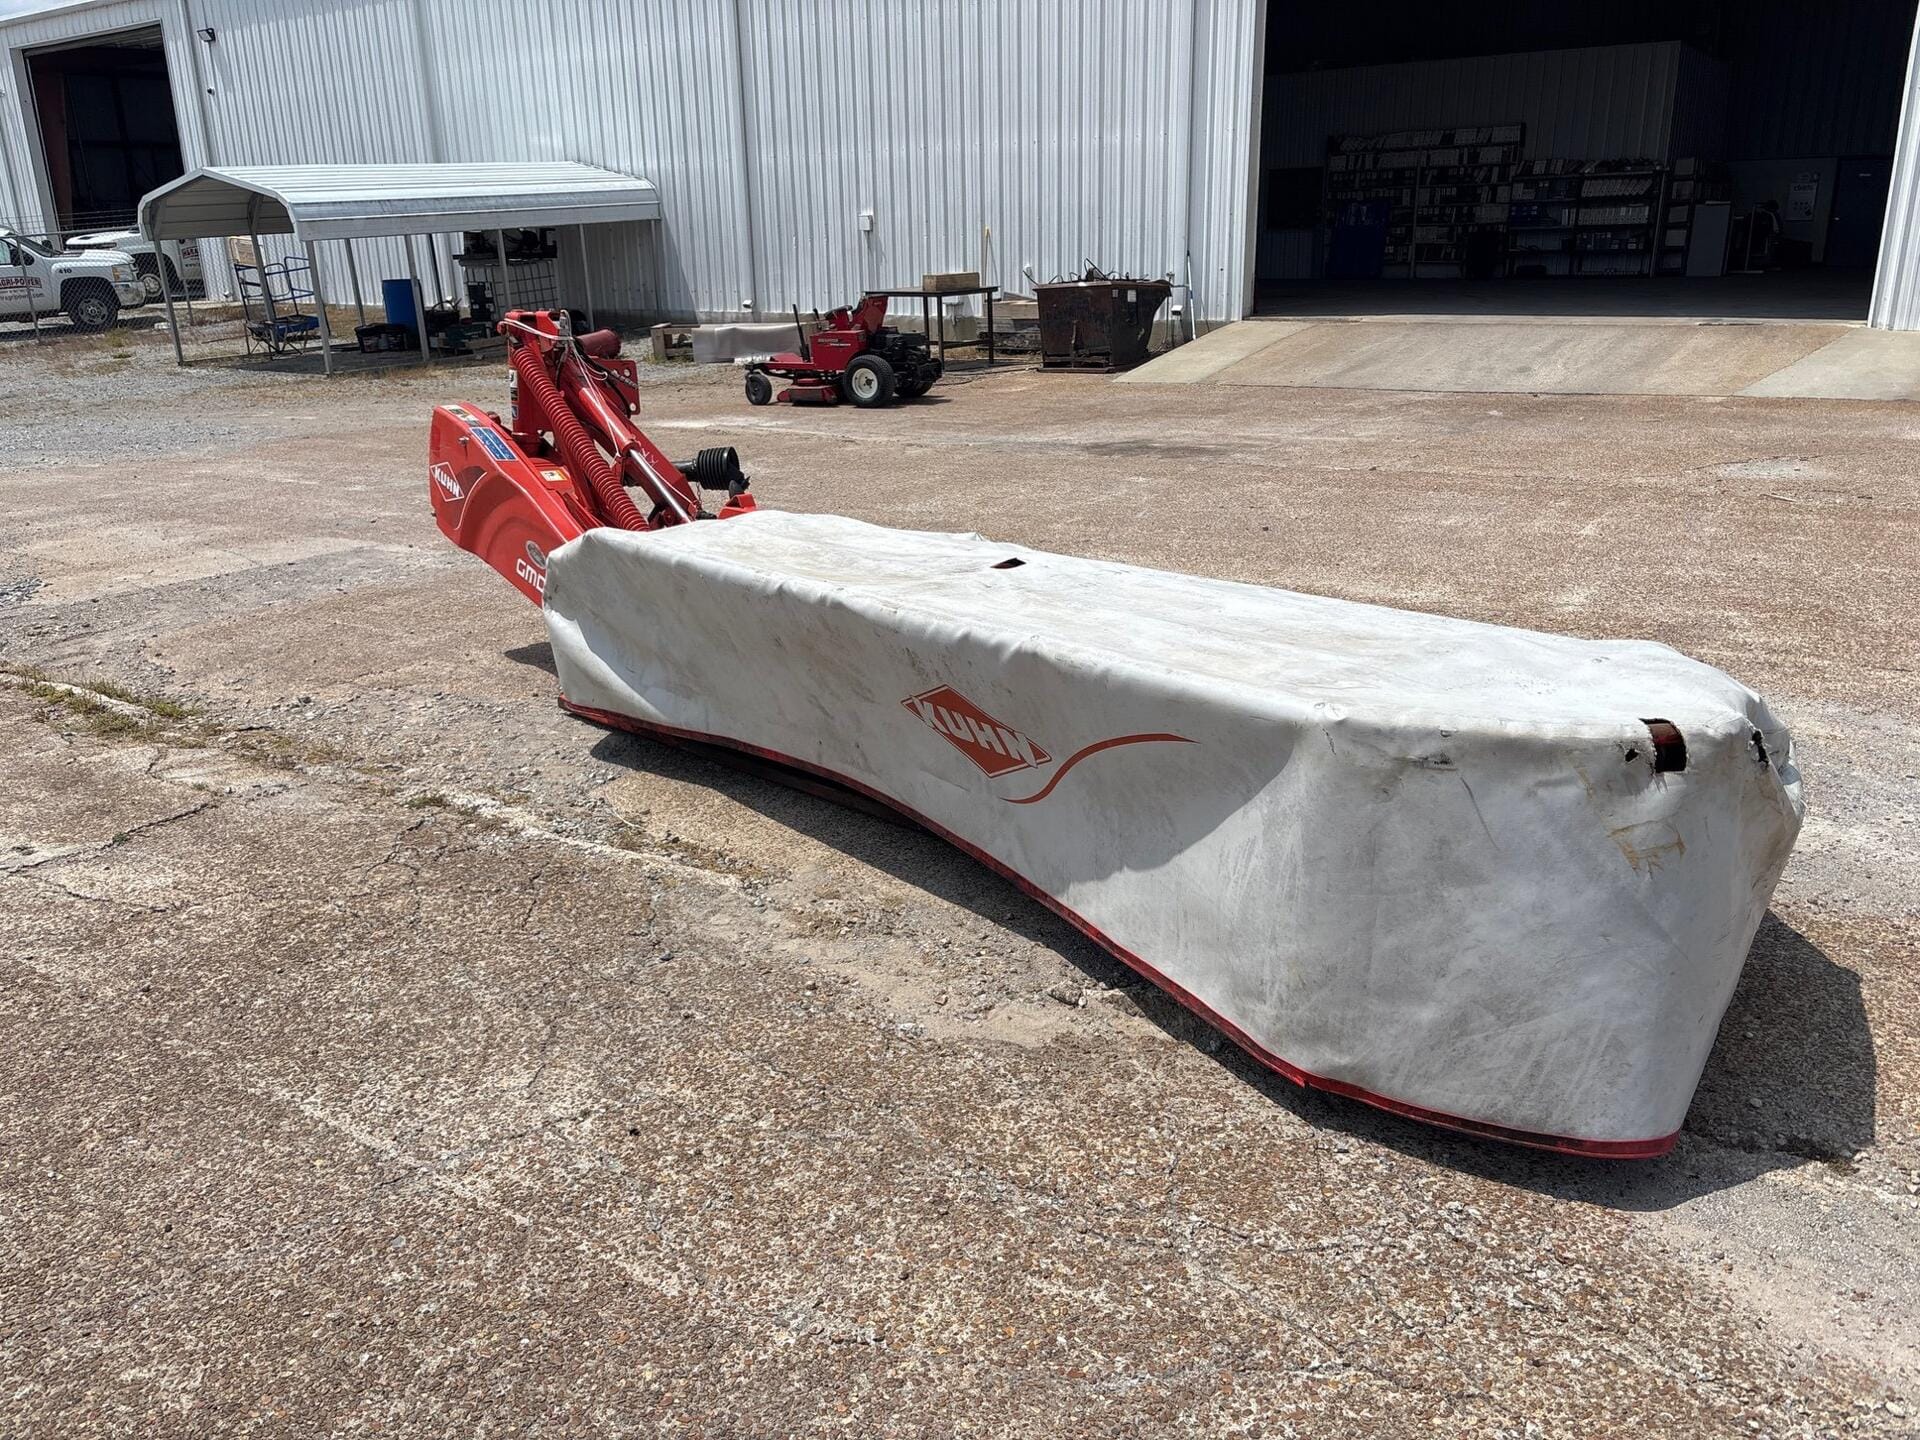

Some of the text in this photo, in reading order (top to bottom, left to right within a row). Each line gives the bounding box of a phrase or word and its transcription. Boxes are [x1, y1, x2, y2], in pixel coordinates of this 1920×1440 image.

[0, 278, 40, 287] GRI-POER
[434, 465, 460, 498] KUHN
[910, 695, 1038, 768] KUHN
